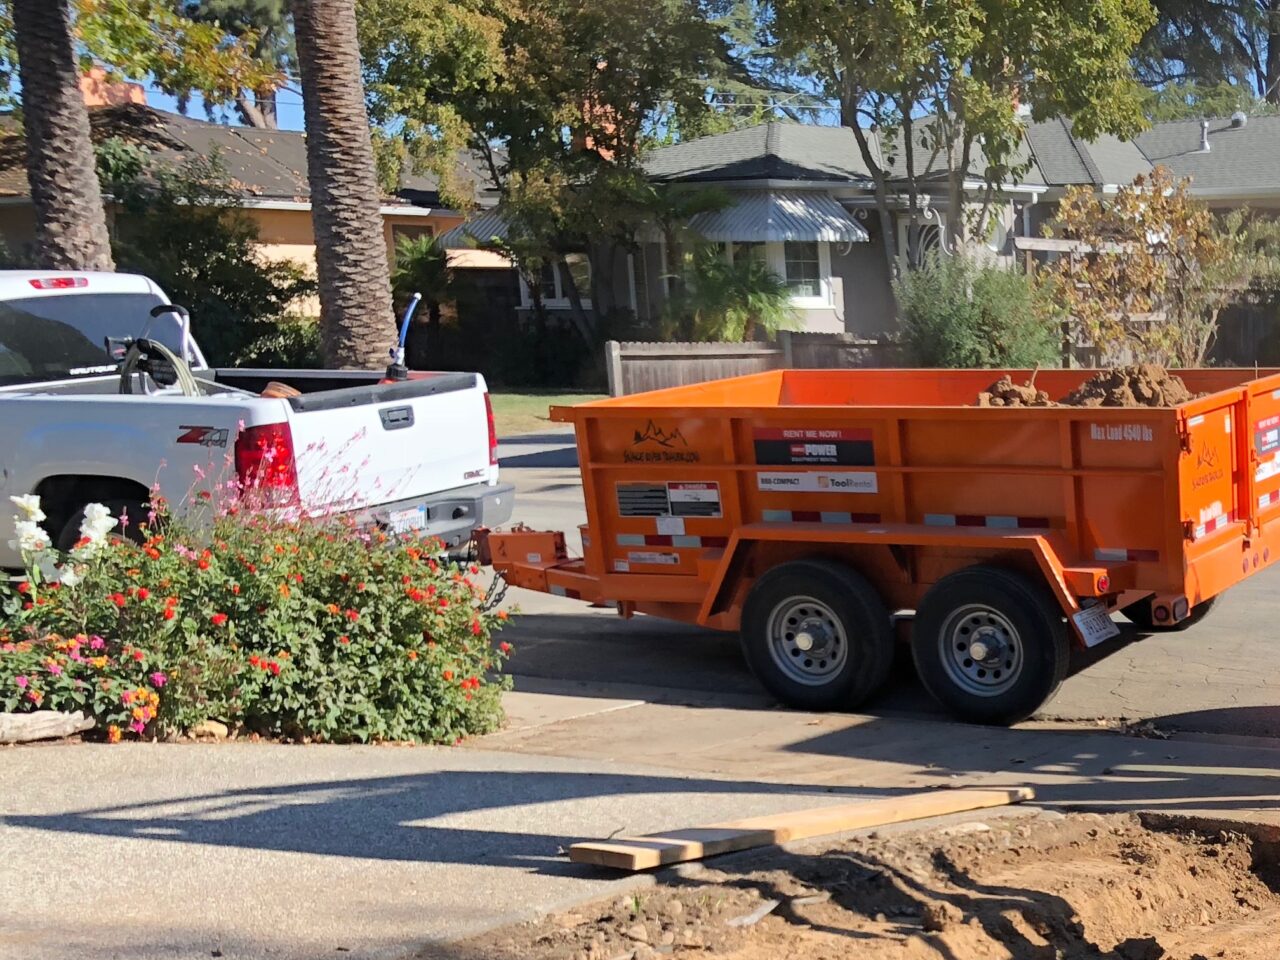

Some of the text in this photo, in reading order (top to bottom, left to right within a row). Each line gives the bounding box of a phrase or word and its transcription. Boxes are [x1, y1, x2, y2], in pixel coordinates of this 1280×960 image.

[783, 430, 804, 438] RENT
[806, 430, 818, 438] ME
[1091, 423, 1105, 440] Max
[1106, 424, 1123, 440] Load
[805, 444, 837, 456] POWER
[464, 469, 484, 480] GMC
